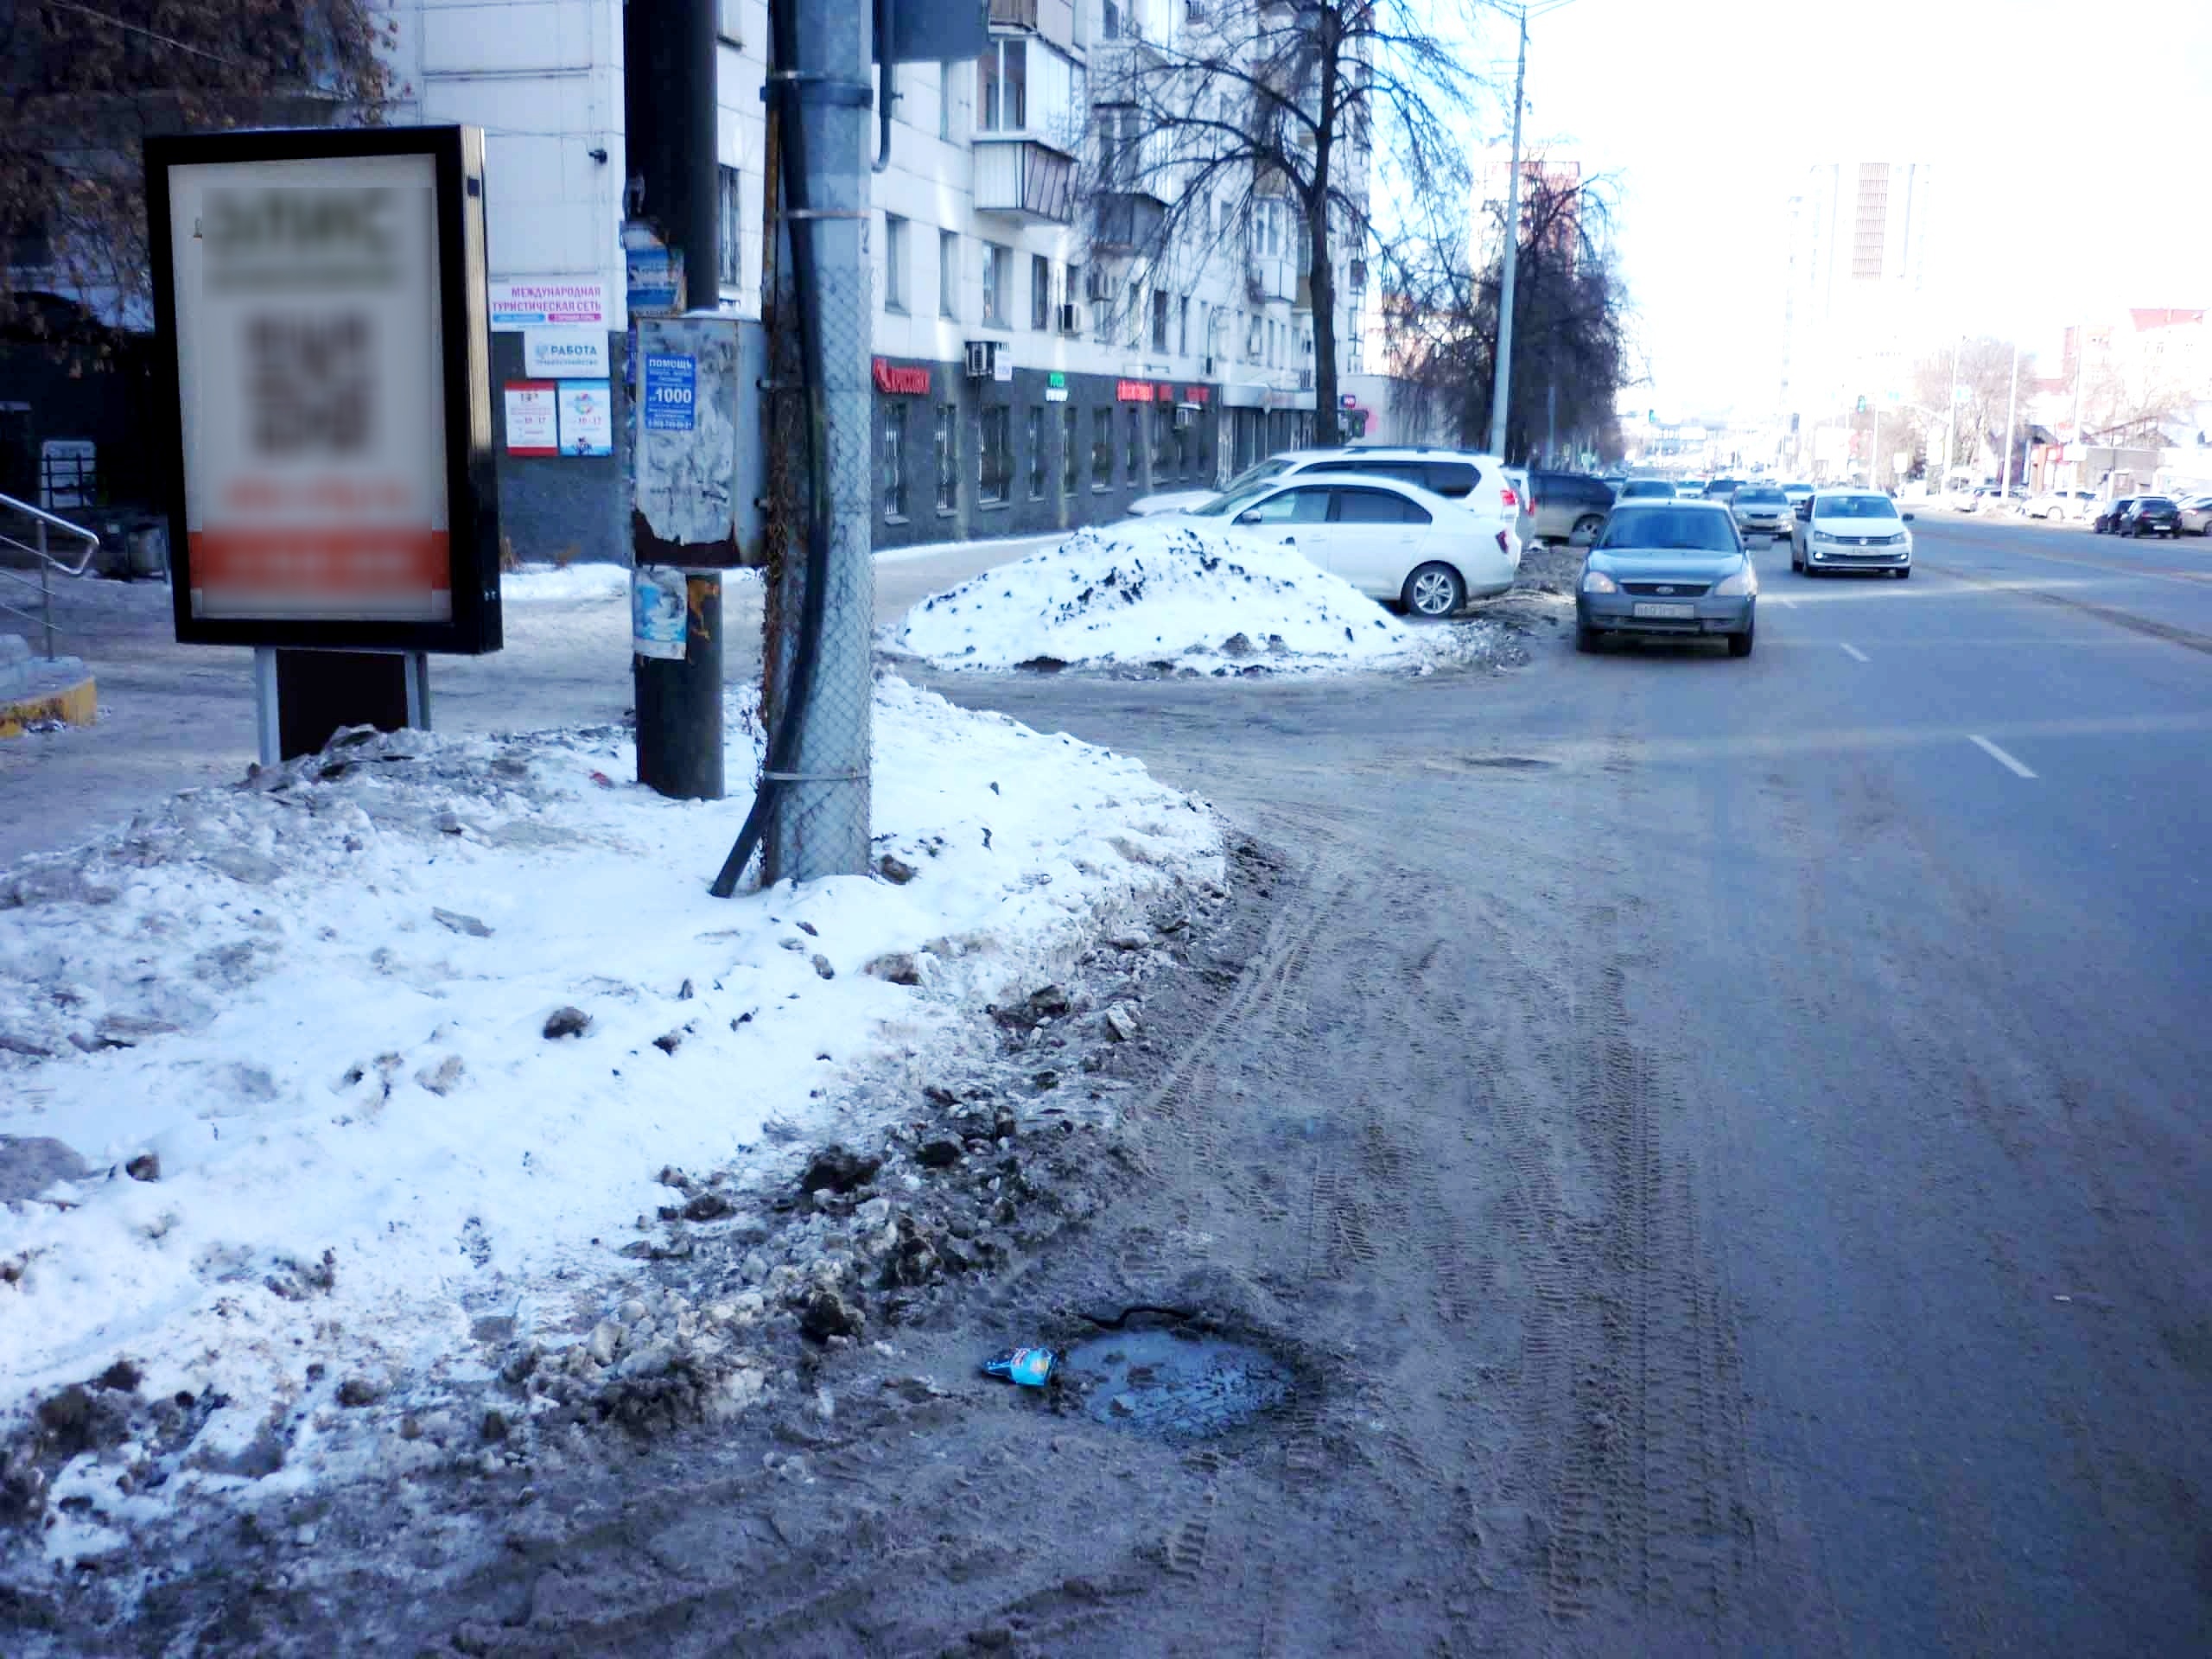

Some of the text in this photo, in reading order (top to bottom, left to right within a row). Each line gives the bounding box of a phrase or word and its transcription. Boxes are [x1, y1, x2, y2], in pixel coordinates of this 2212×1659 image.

[511, 287, 601, 298] МЕЖДУНАРОДНАЯ
[492, 301, 601, 312] ТУРИСТИЧЕСКАЯ СЕТЬ
[550, 345, 597, 355] РАБОТА
[655, 387, 692, 404] 1000
